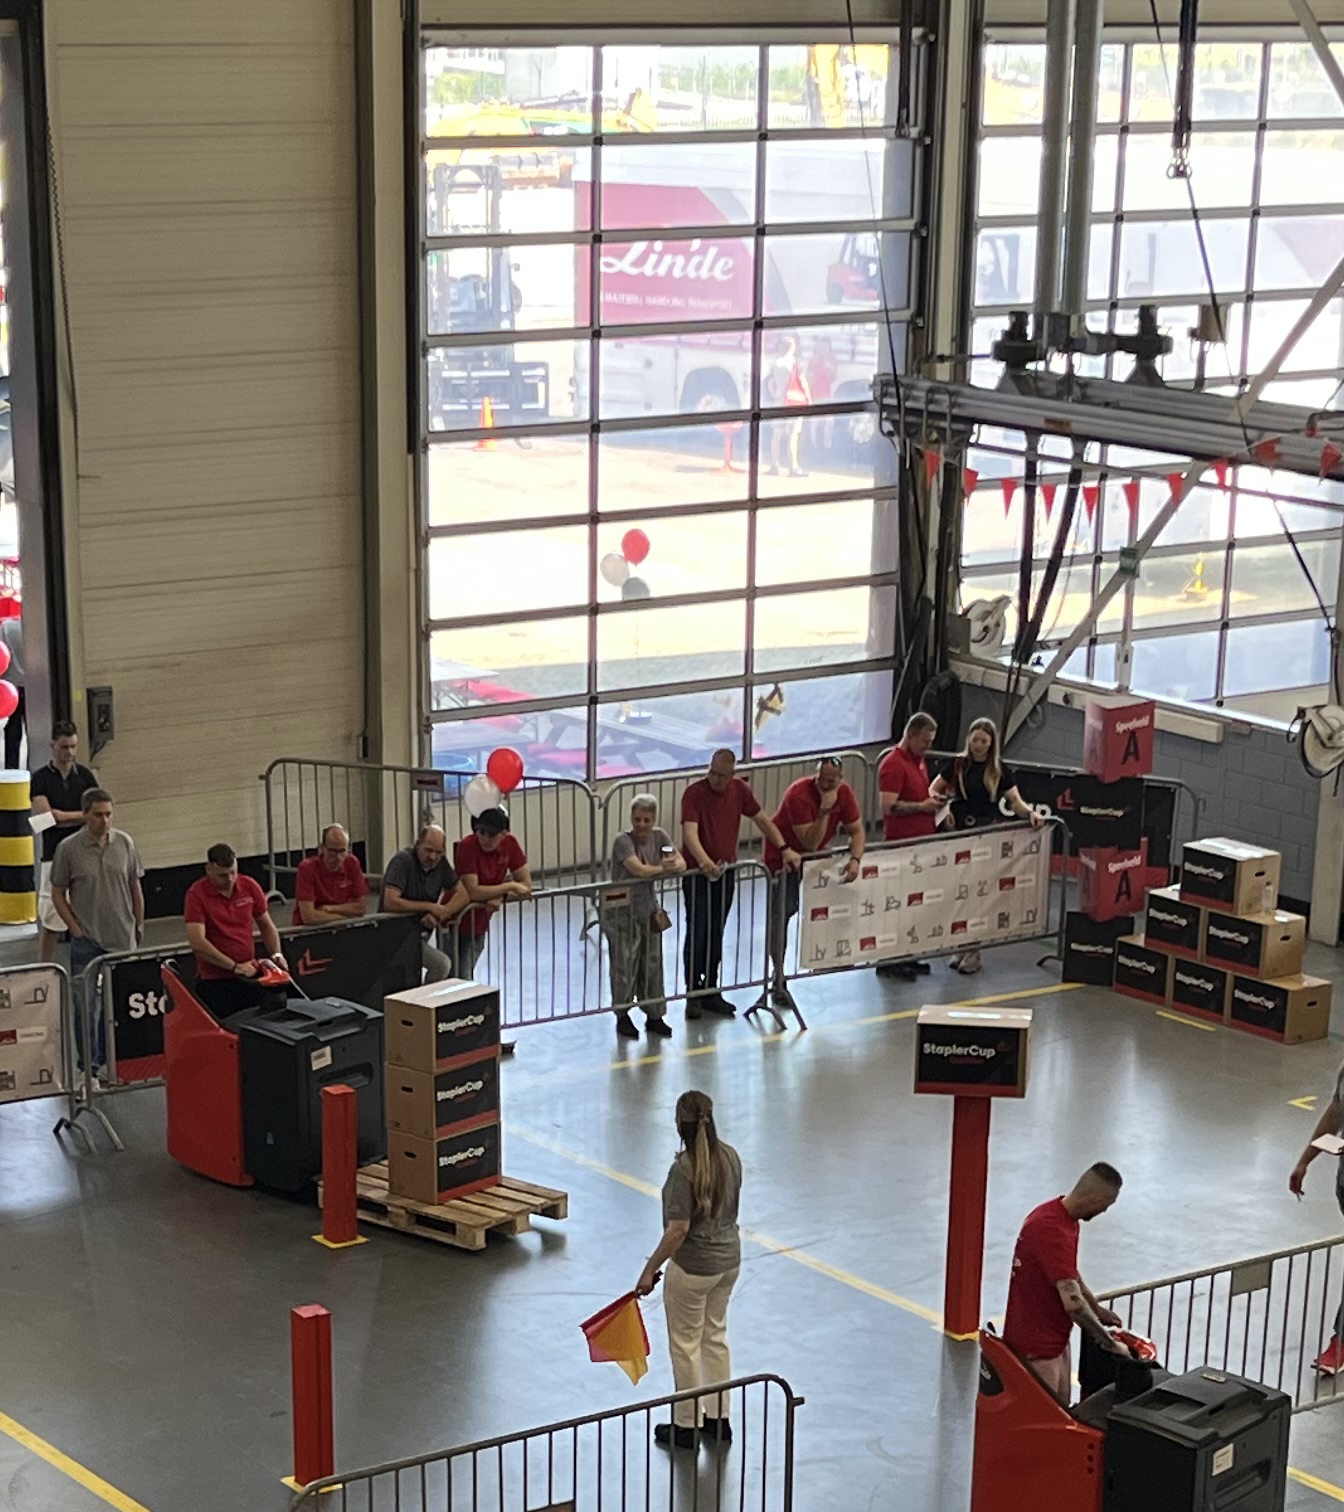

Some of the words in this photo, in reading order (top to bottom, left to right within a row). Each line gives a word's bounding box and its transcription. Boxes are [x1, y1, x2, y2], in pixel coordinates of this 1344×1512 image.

[600, 239, 734, 281] Linde
[1120, 731, 1141, 765] A
[1115, 870, 1132, 905] A
[922, 1042, 996, 1060] StaplerCup
